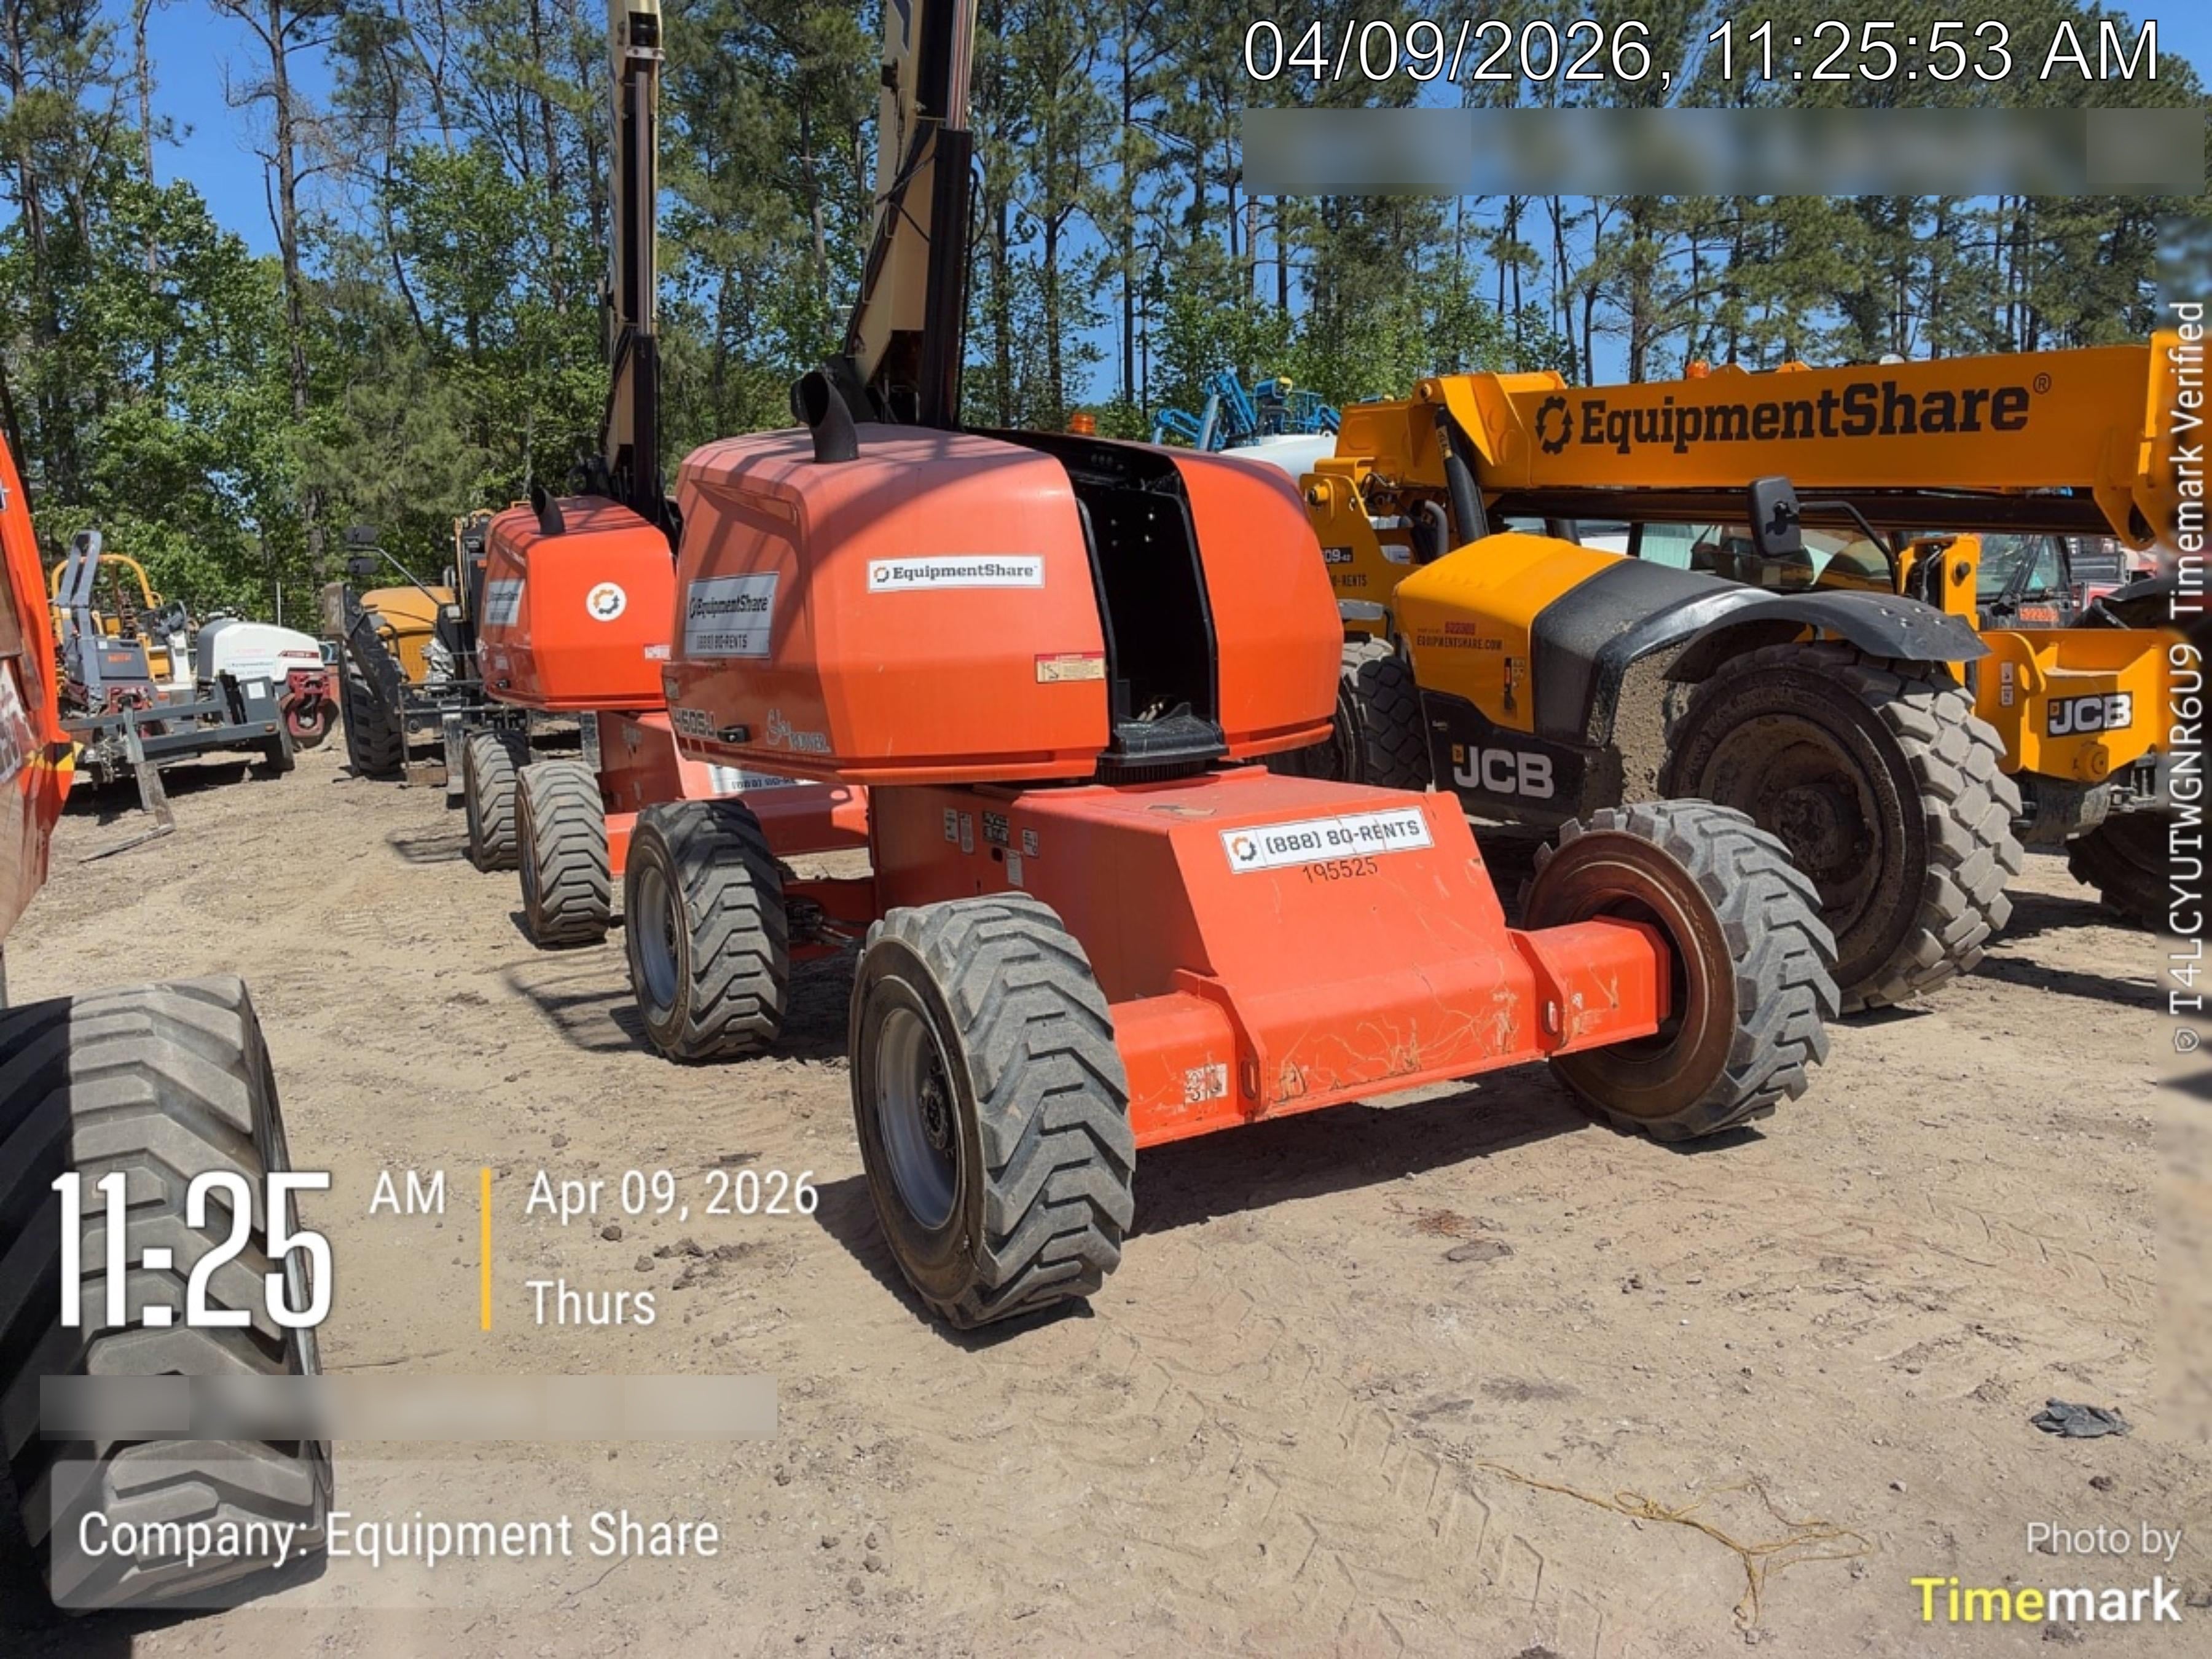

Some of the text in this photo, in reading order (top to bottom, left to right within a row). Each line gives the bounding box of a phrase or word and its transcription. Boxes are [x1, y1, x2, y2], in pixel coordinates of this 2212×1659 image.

[2049, 694, 2132, 734] JCB
[1454, 745, 1555, 799] JCB
[1265, 820, 1420, 855] (888) 80-RENTS
[1303, 857, 1378, 883] 195525
